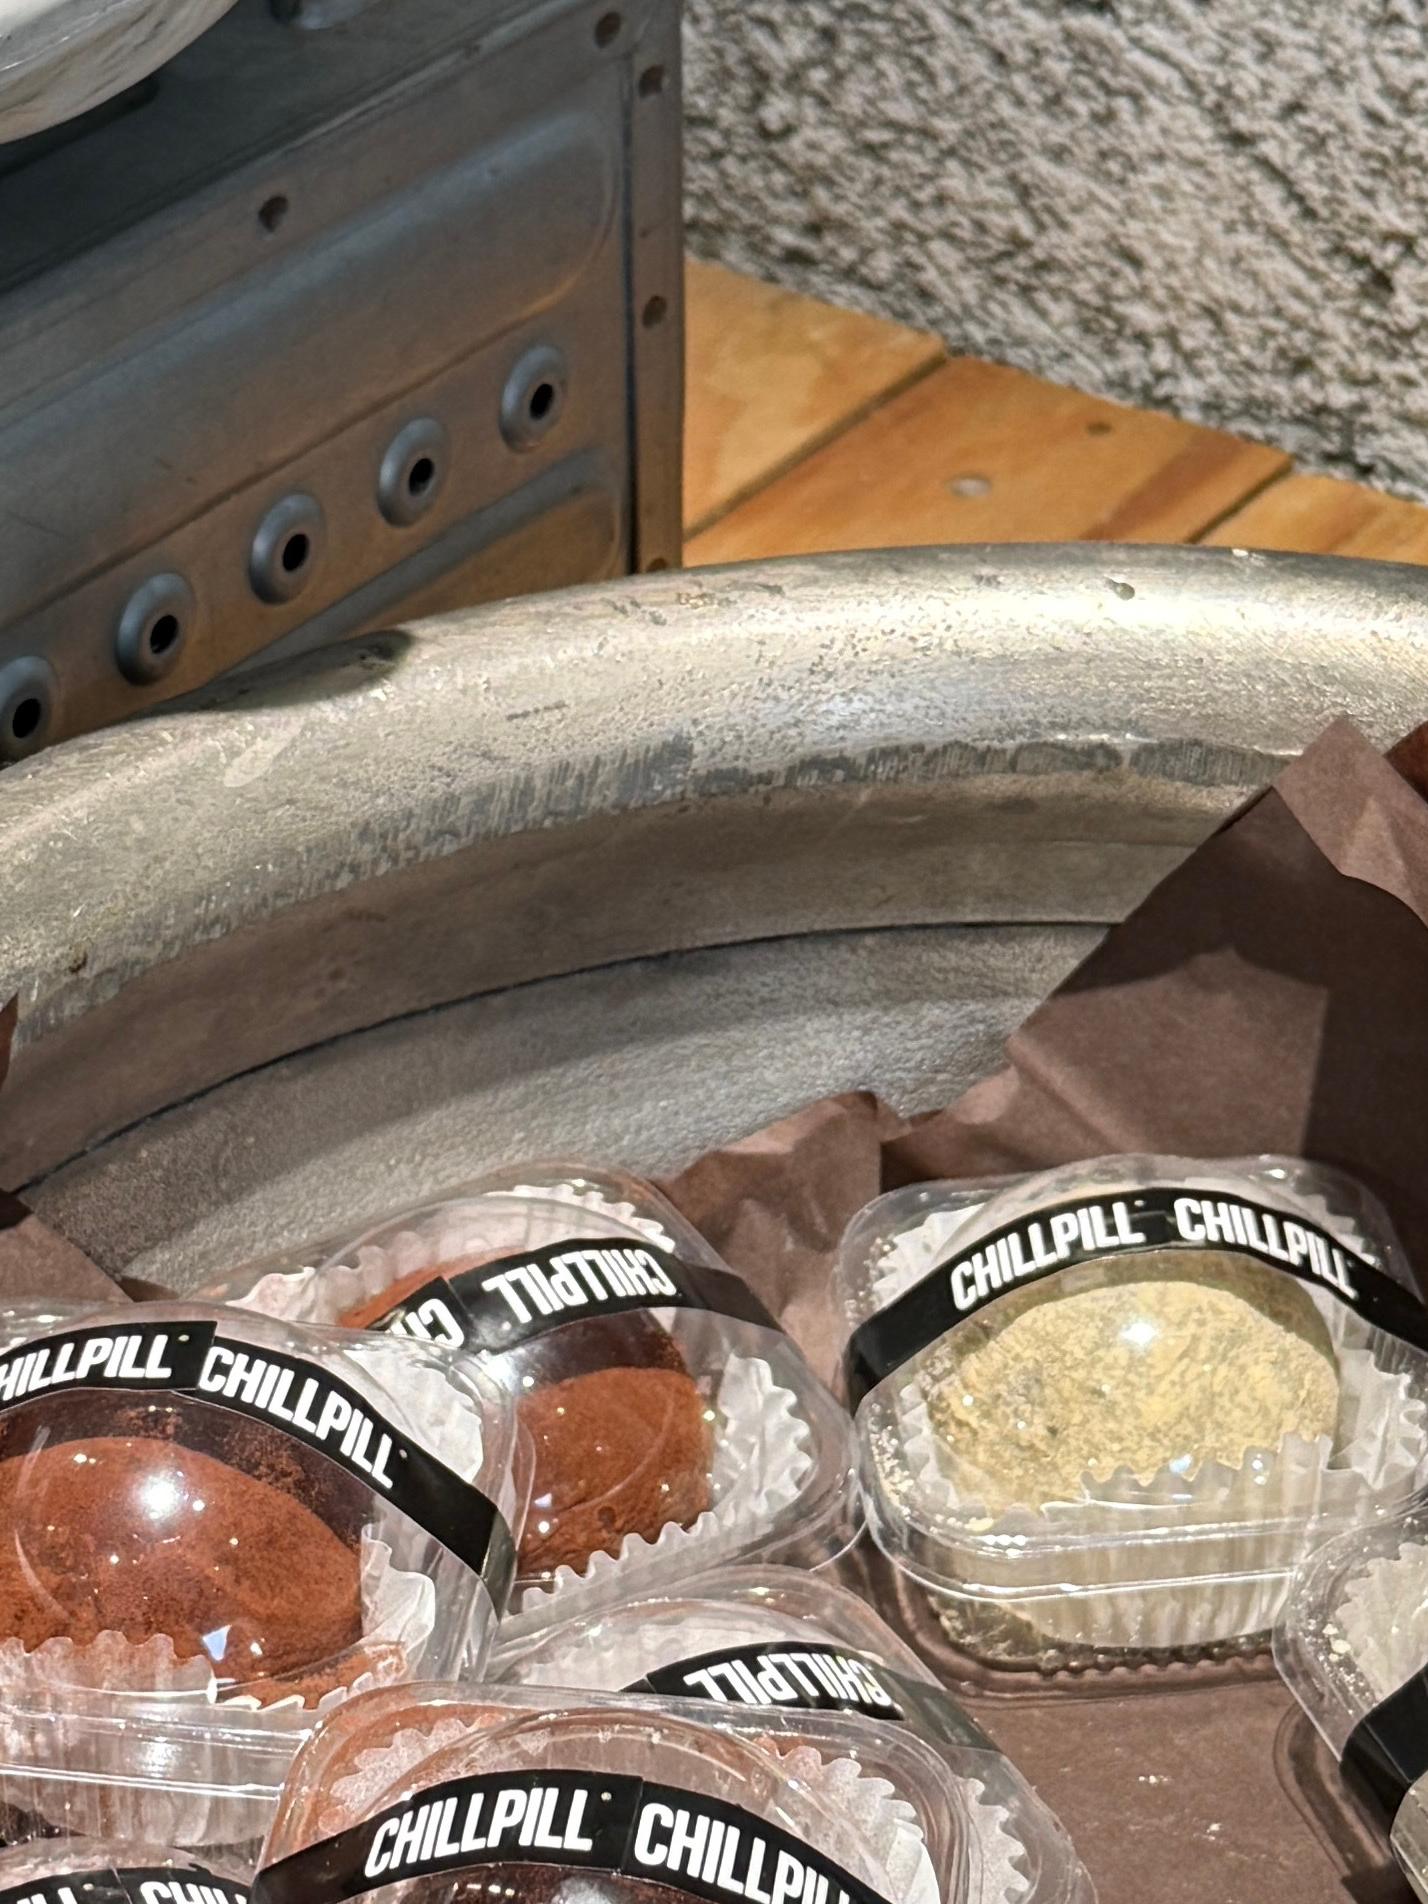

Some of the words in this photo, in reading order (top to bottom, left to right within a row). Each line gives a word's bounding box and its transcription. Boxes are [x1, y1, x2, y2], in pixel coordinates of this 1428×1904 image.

[481, 1248, 678, 1325] CHILLPILL
[951, 1201, 1146, 1310] CHILLPILL
[1174, 1197, 1357, 1299] CHILLPILL
[198, 1346, 396, 1489] CHILLPILL
[682, 1652, 892, 1707] CHILLPILL
[364, 1789, 593, 1878] CHILLPILL
